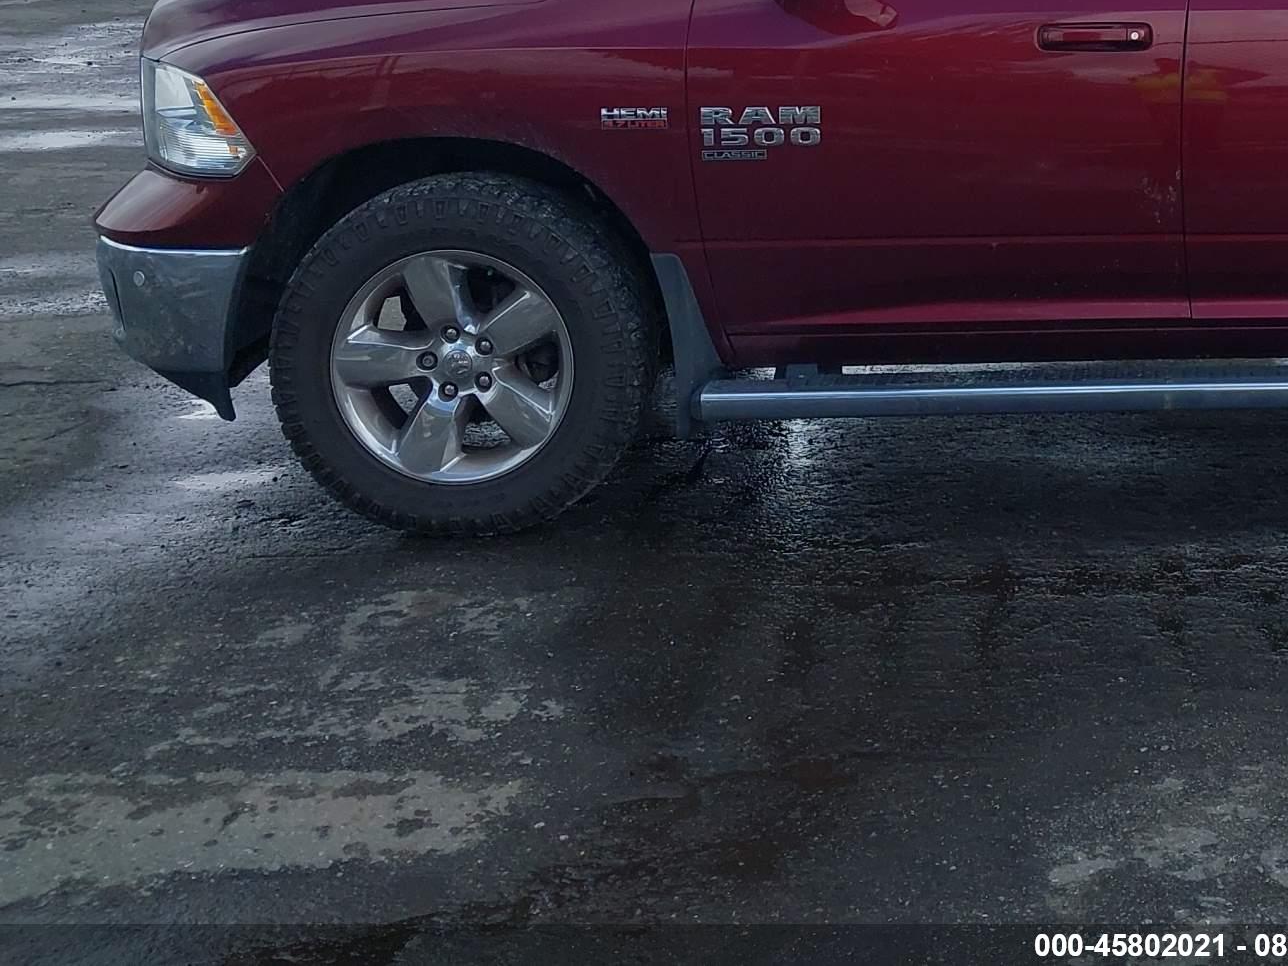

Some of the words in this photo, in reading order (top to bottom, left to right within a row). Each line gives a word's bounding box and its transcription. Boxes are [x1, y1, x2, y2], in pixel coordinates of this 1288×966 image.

[600, 107, 668, 120] HEMI
[700, 106, 821, 125] RAM
[700, 127, 821, 146] 1500
[703, 151, 766, 160] CLASSIC
